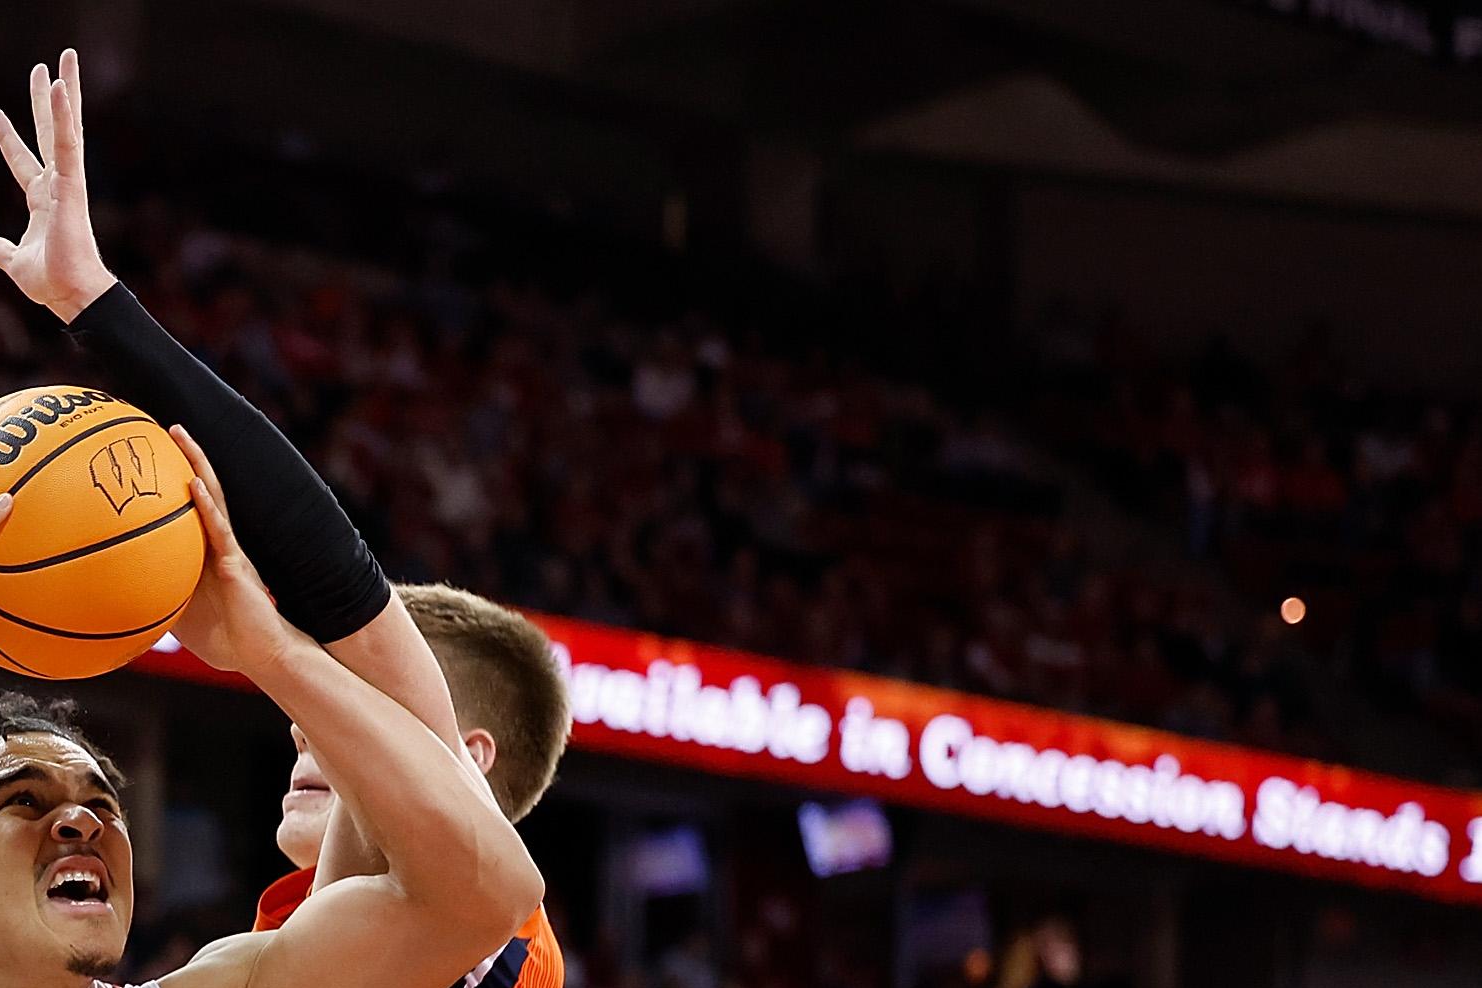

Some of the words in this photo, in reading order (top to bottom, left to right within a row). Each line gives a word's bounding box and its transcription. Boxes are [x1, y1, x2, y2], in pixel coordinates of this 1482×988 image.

[59, 412, 83, 429] EVO
[89, 436, 161, 516] W
[559, 642, 832, 765] vailable
[839, 696, 912, 780] in
[919, 714, 1246, 840] Concession
[1252, 776, 1451, 877] Stands
